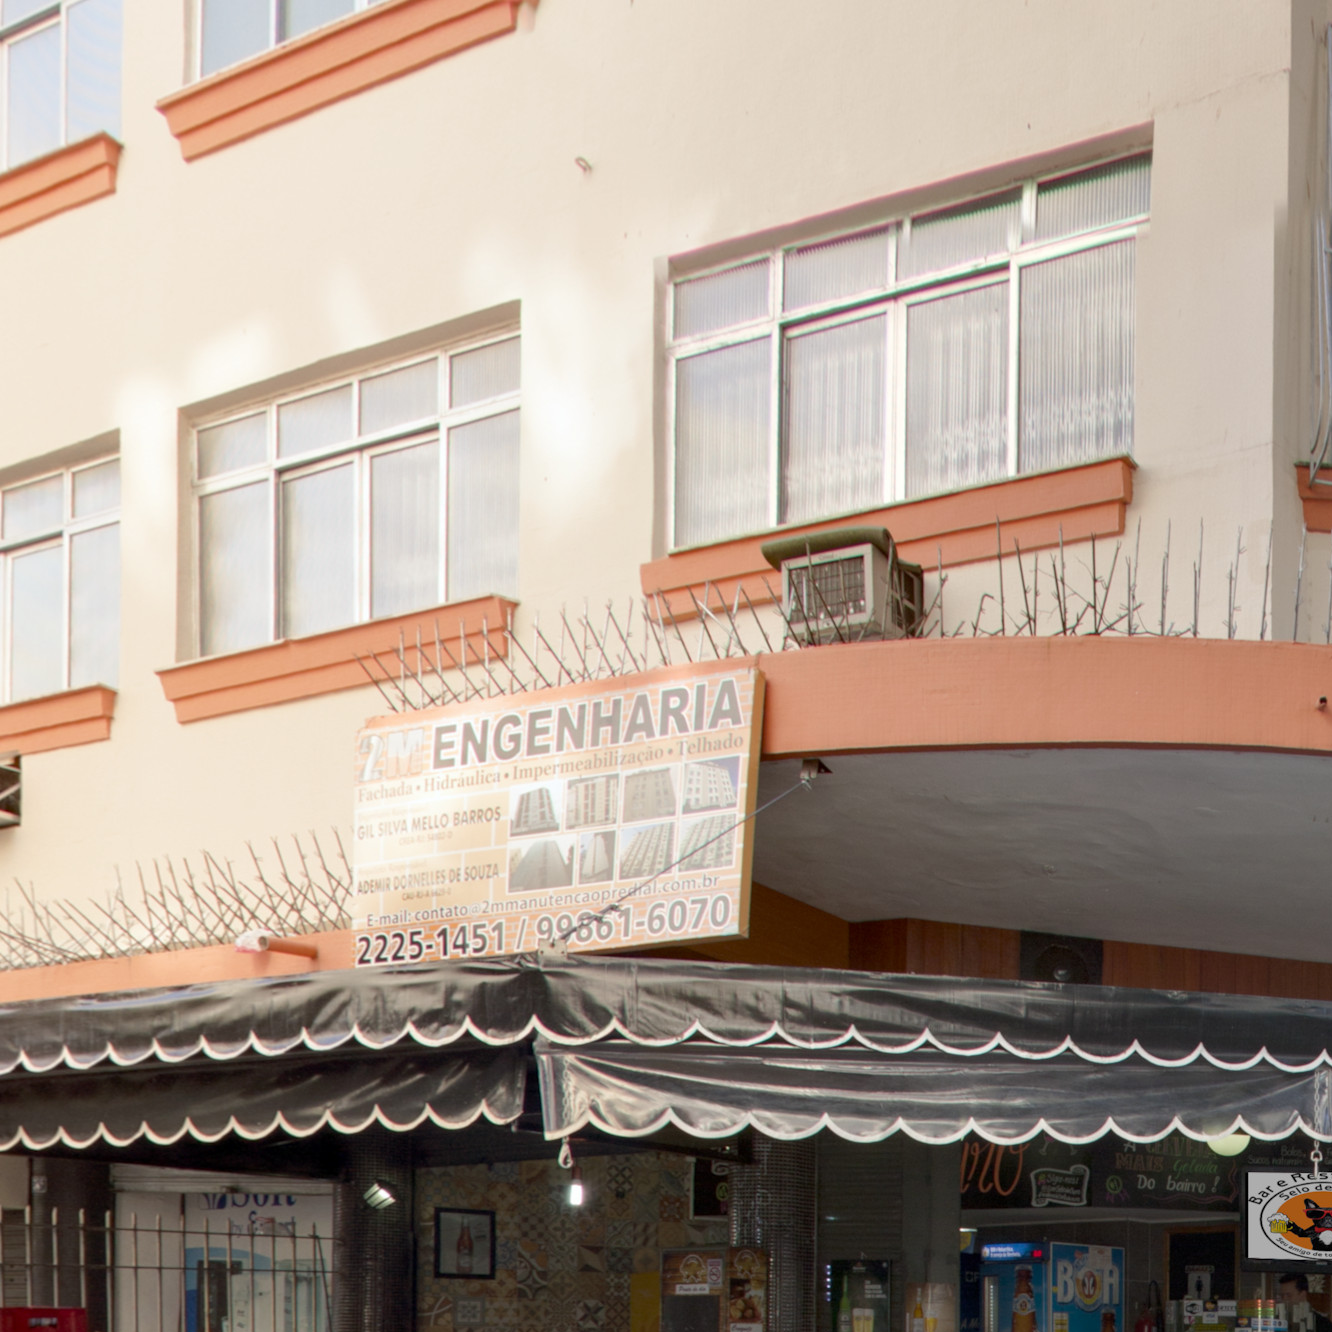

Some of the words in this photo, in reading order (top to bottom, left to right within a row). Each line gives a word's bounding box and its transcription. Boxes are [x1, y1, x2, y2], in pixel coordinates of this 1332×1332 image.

[357, 728, 424, 784] 2M
[432, 677, 743, 770] ENGENHARIA
[357, 781, 413, 803] Fachada
[424, 770, 500, 793] Hidráulica
[512, 747, 664, 782] Impermeabilização
[676, 733, 744, 756] Telhado
[357, 825, 375, 840] GIL
[378, 819, 407, 837] SILVA
[411, 813, 449, 833] MELLO
[453, 806, 501, 826] BARROS
[357, 876, 391, 895] ADEMIR
[392, 869, 446, 891] DORNELLES
[449, 866, 462, 884] DE
[464, 863, 499, 882] SOUZA
[367, 909, 411, 927] E-mail:
[414, 874, 720, 922] contato@2mmanutencaopredial.com.br
[357, 919, 504, 965] 2225-1451
[1115, 1152, 1164, 1172] MAIS
[1173, 1159, 1218, 1179] Gelada
[1137, 1174, 1156, 1190] Do
[1166, 1175, 1206, 1194] bairro
[1249, 1185, 1275, 1206] Bar
[1276, 1179, 1288, 1188] e
[1279, 1184, 1310, 1201] Selo
[1315, 1183, 1332, 1192] de
[1275, 1237, 1288, 1247] Seu
[1288, 1244, 1312, 1257] amigo
[1312, 1250, 1323, 1258] de
